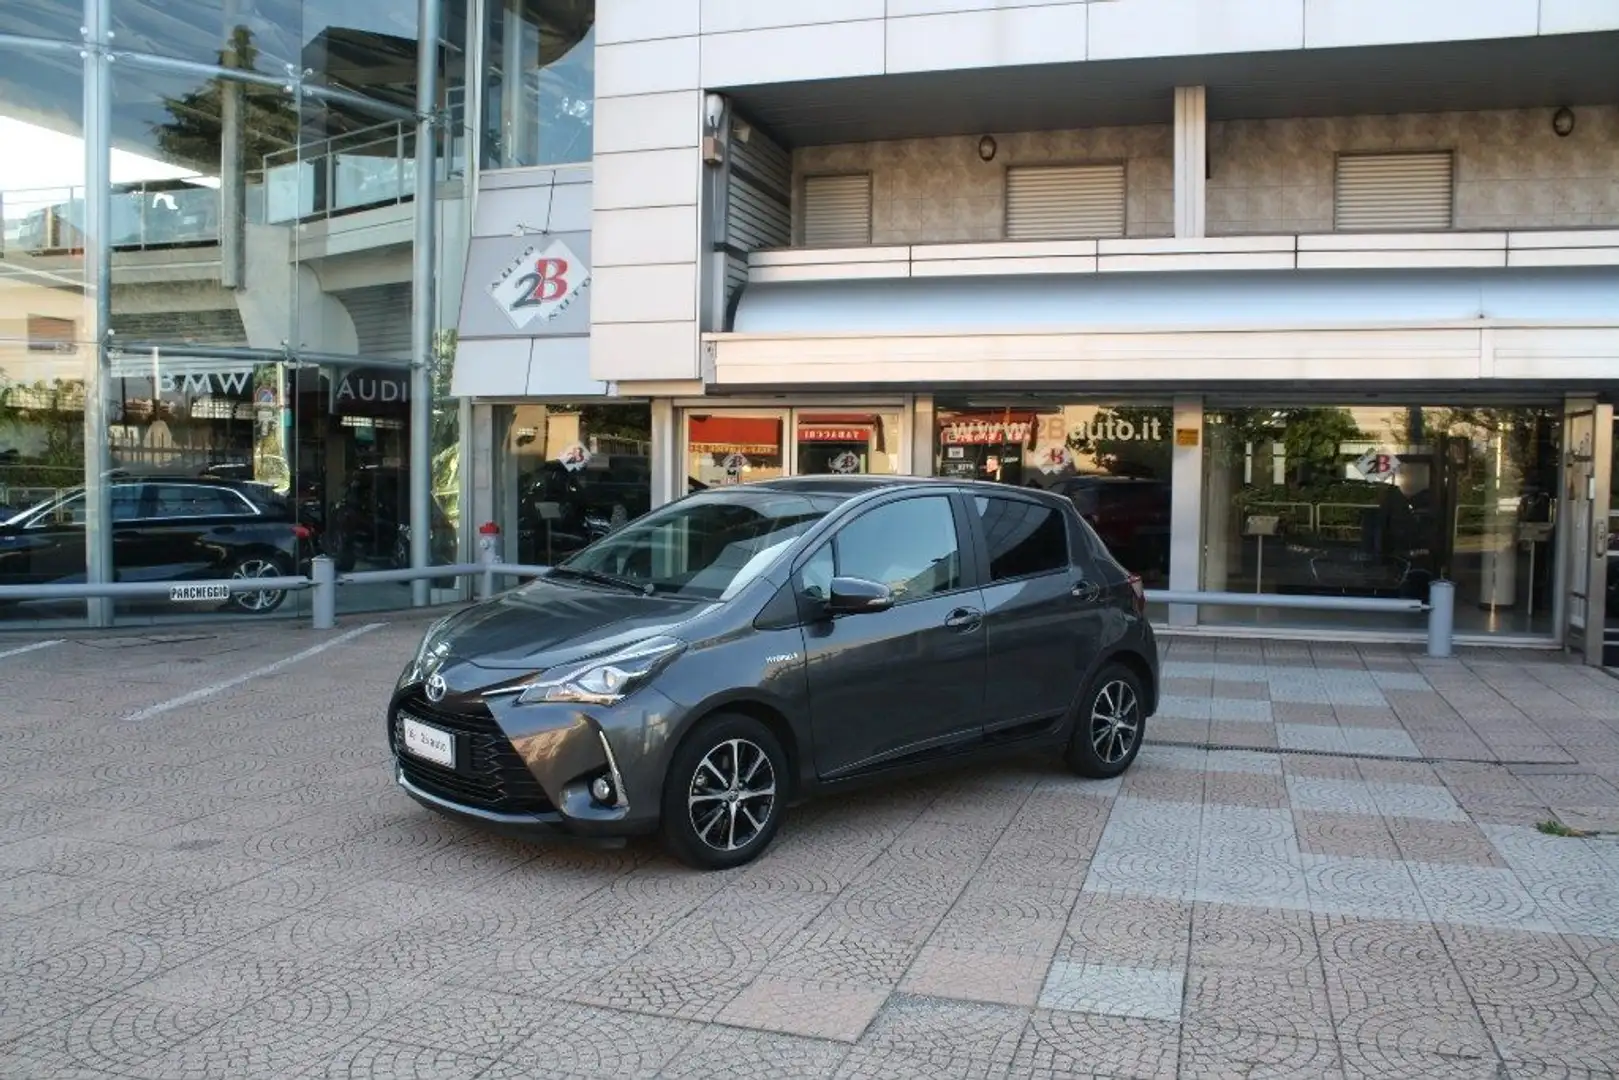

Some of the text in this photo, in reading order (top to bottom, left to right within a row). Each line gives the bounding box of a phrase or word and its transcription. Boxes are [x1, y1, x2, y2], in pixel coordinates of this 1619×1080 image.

[509, 257, 568, 312] 2B
[159, 371, 251, 396] BMW
[336, 378, 407, 403] AUDI
[1367, 453, 1392, 474] 2B
[171, 586, 229, 599] PARCHEGGIO
